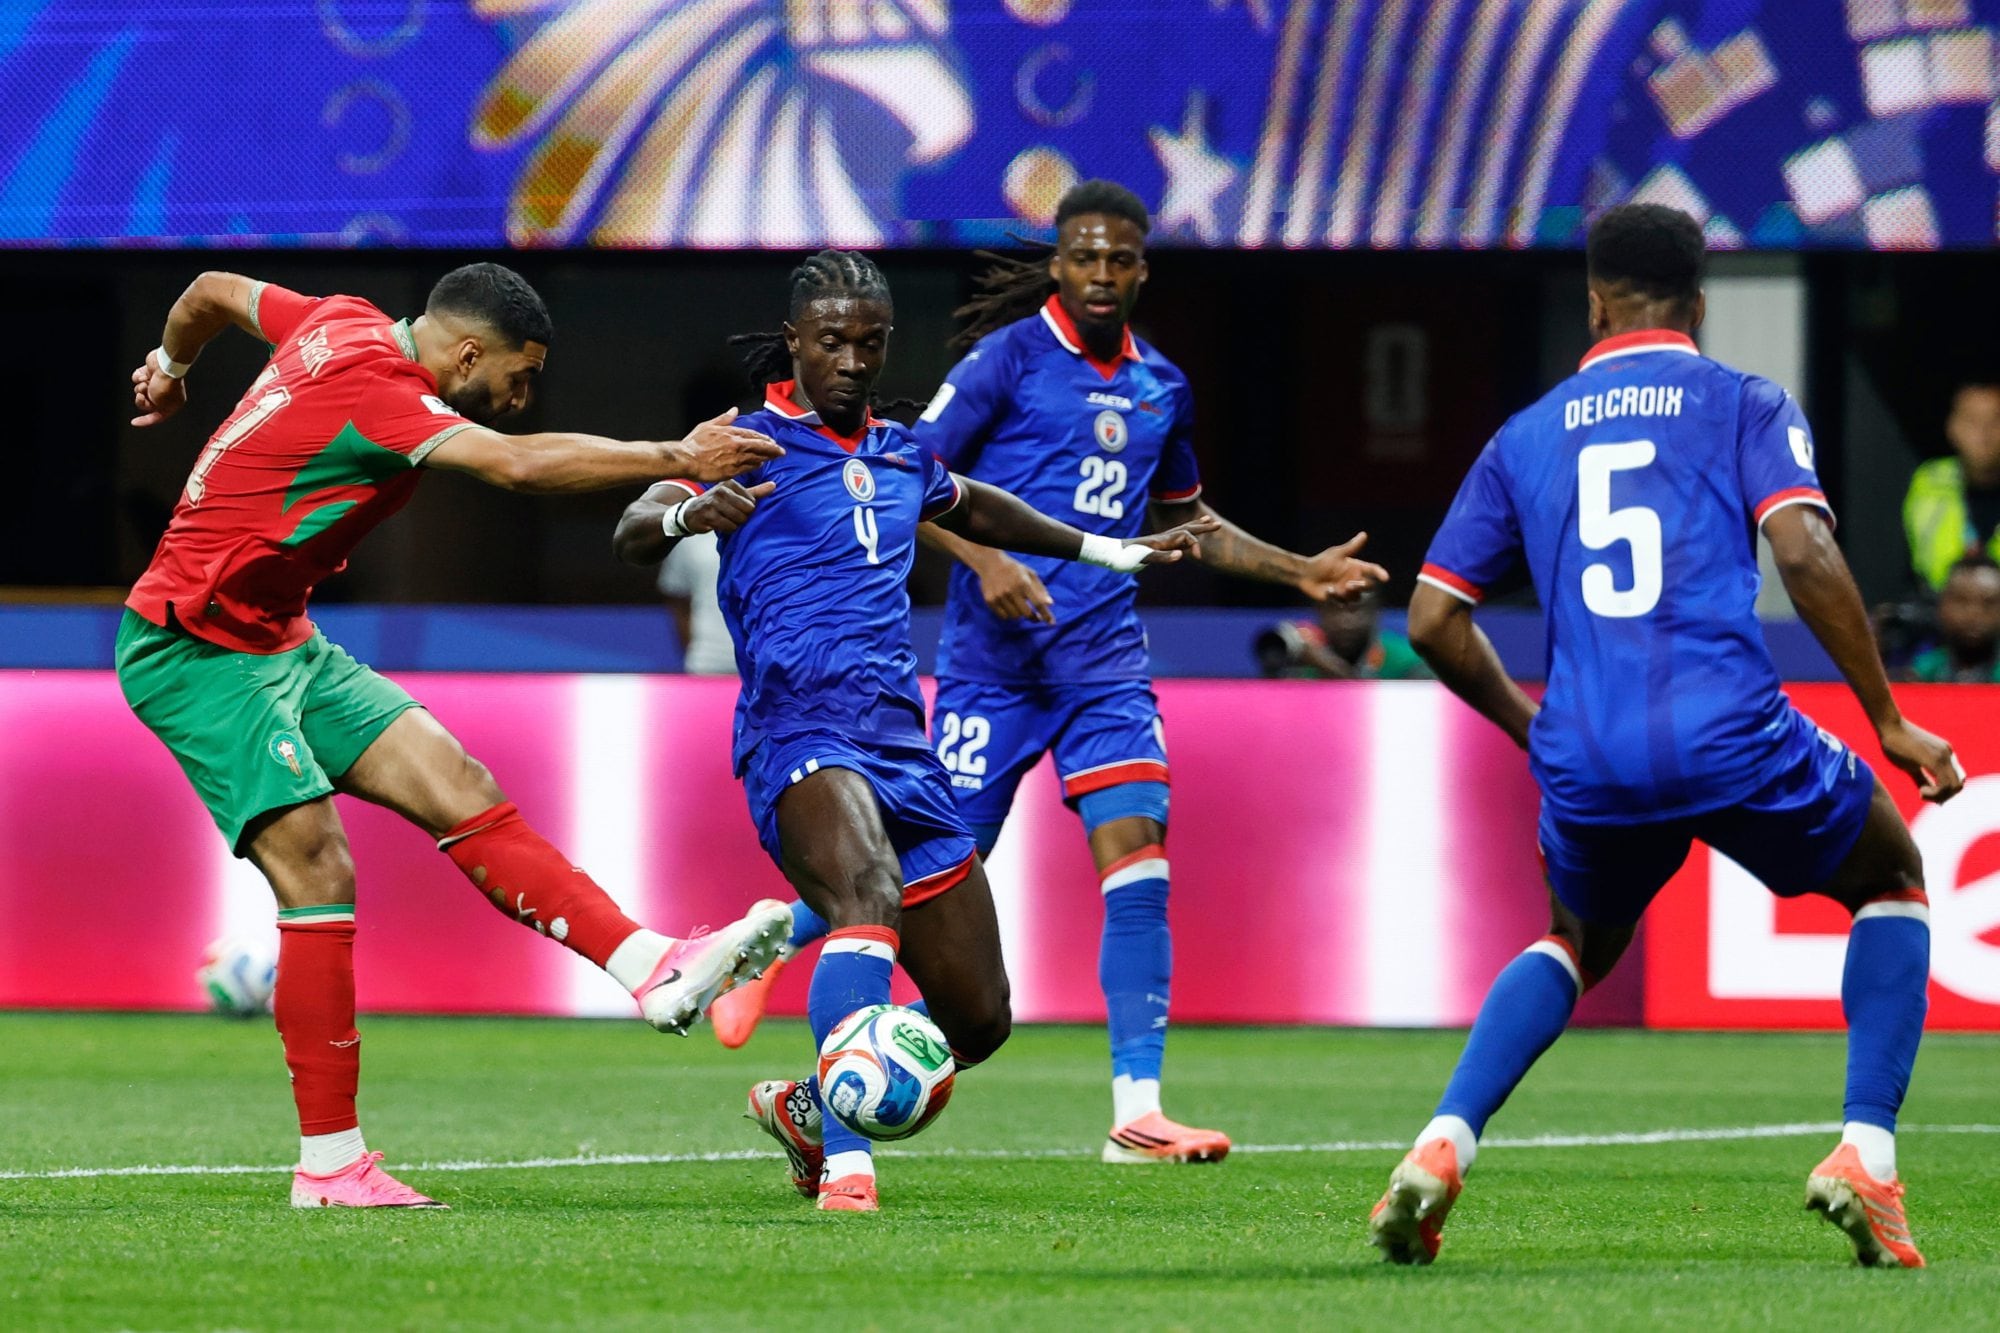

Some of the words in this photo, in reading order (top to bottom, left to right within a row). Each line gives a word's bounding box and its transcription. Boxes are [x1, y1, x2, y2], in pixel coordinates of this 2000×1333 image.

[1564, 385, 1684, 431] DELCROIX
[1073, 455, 1127, 520] 22
[853, 505, 880, 565] 4
[1577, 439, 1662, 618] 5
[936, 711, 991, 776] 22
